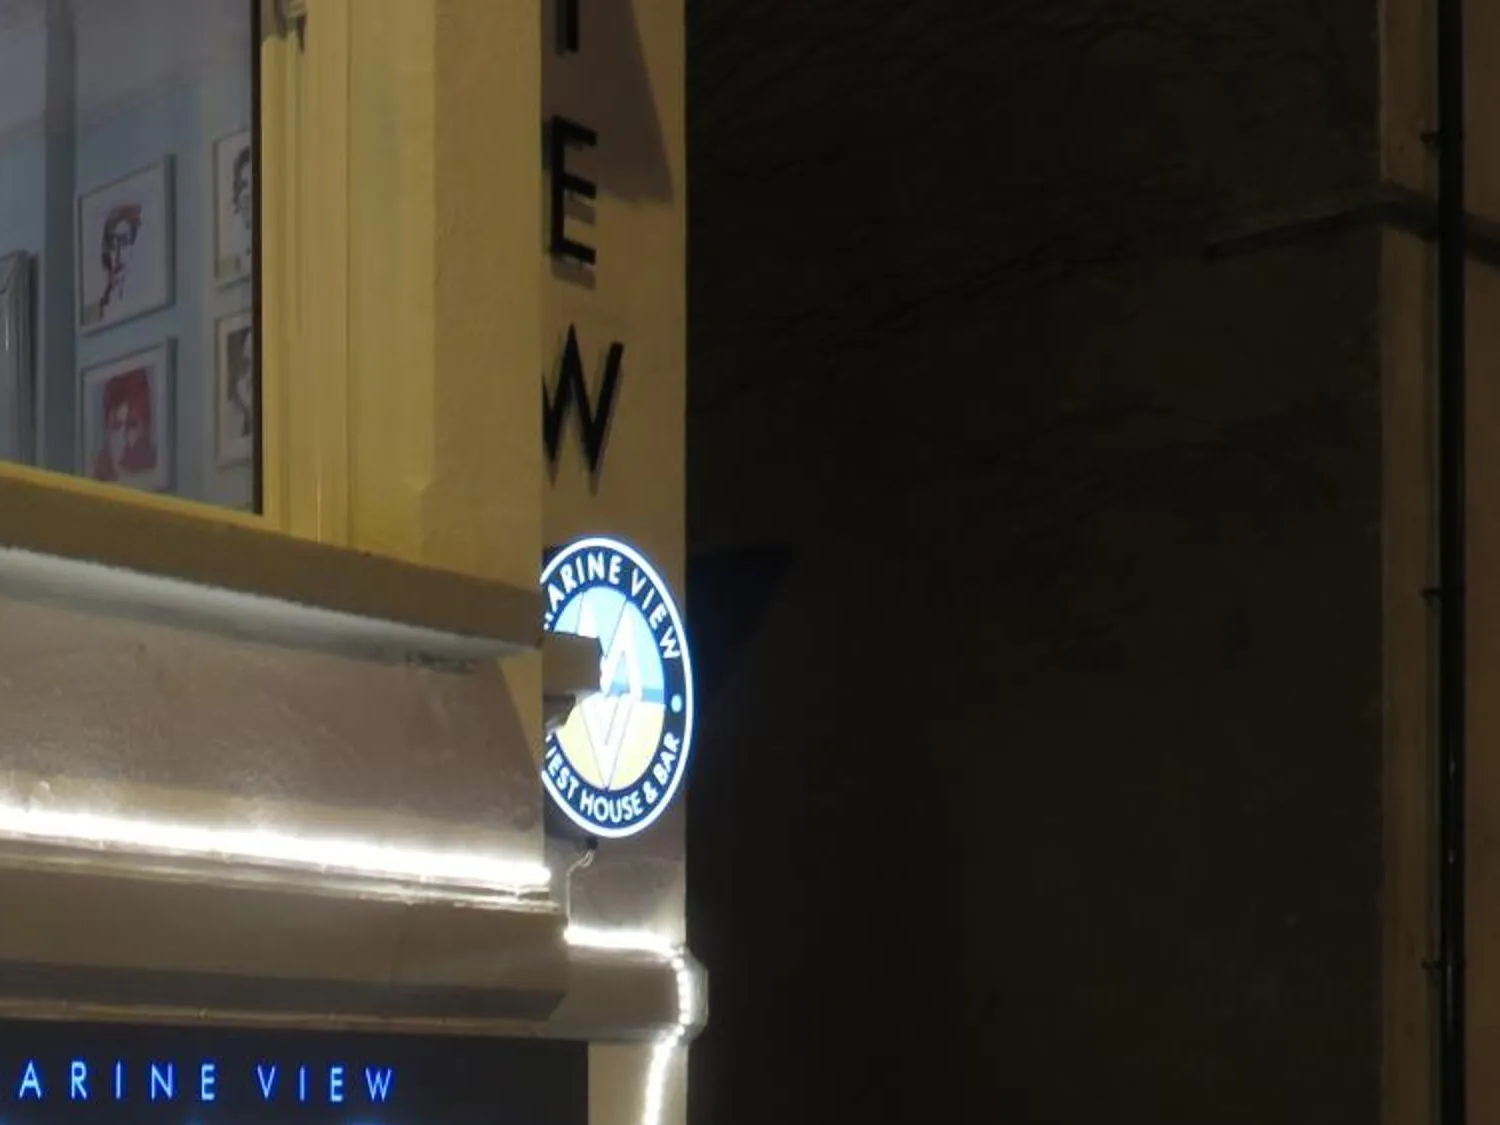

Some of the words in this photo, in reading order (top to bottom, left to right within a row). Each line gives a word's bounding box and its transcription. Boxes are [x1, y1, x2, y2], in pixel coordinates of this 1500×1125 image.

[543, 551, 622, 630] ARINE
[631, 567, 681, 661] VIEW
[580, 787, 643, 823] HOUSE
[643, 780, 660, 801] &
[654, 731, 681, 779] BAR
[257, 1065, 393, 1103] VIEW
